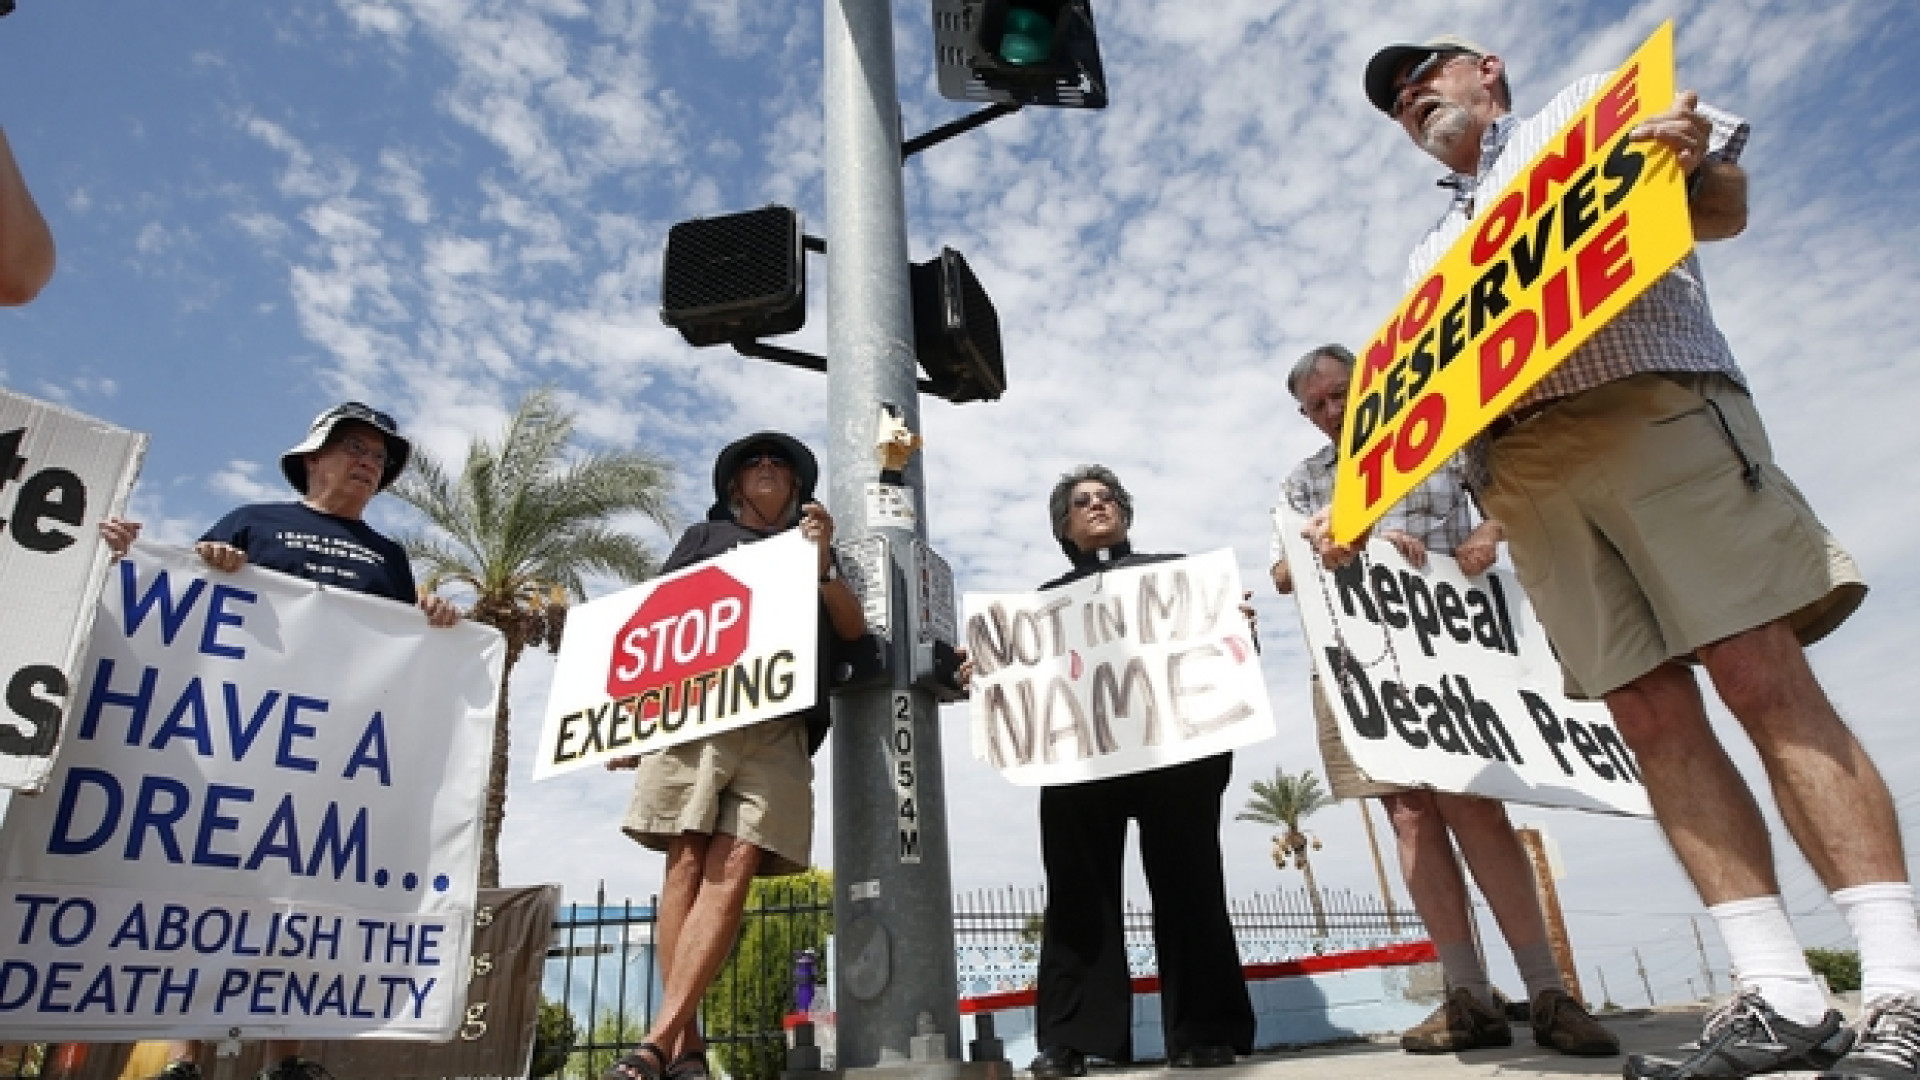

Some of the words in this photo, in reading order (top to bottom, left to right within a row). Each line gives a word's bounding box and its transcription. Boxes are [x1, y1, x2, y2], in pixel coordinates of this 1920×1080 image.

[1360, 274, 1444, 395] NO
[1471, 62, 1640, 266] ONE
[1350, 127, 1646, 458] DESERVES
[1358, 392, 1447, 508] TO
[1479, 211, 1636, 407] DIE
[121, 559, 258, 660] WE
[615, 597, 742, 682] STOP
[968, 595, 1073, 677] NOT
[1083, 595, 1127, 648] IN
[1138, 570, 1231, 644] MY
[79, 658, 329, 773] HAVE
[343, 711, 392, 786] A
[553, 650, 796, 765] EXECUTING
[985, 644, 1255, 768] NAME
[1325, 646, 1524, 764] Death
[46, 766, 450, 892] DREAM...
[896, 695, 918, 855] 2054M
[0, 959, 199, 1016] DEATH
[213, 968, 436, 1019] PENALTY
[14, 894, 97, 947] TO
[108, 901, 341, 962] ABOLISH
[358, 919, 444, 966] THE
